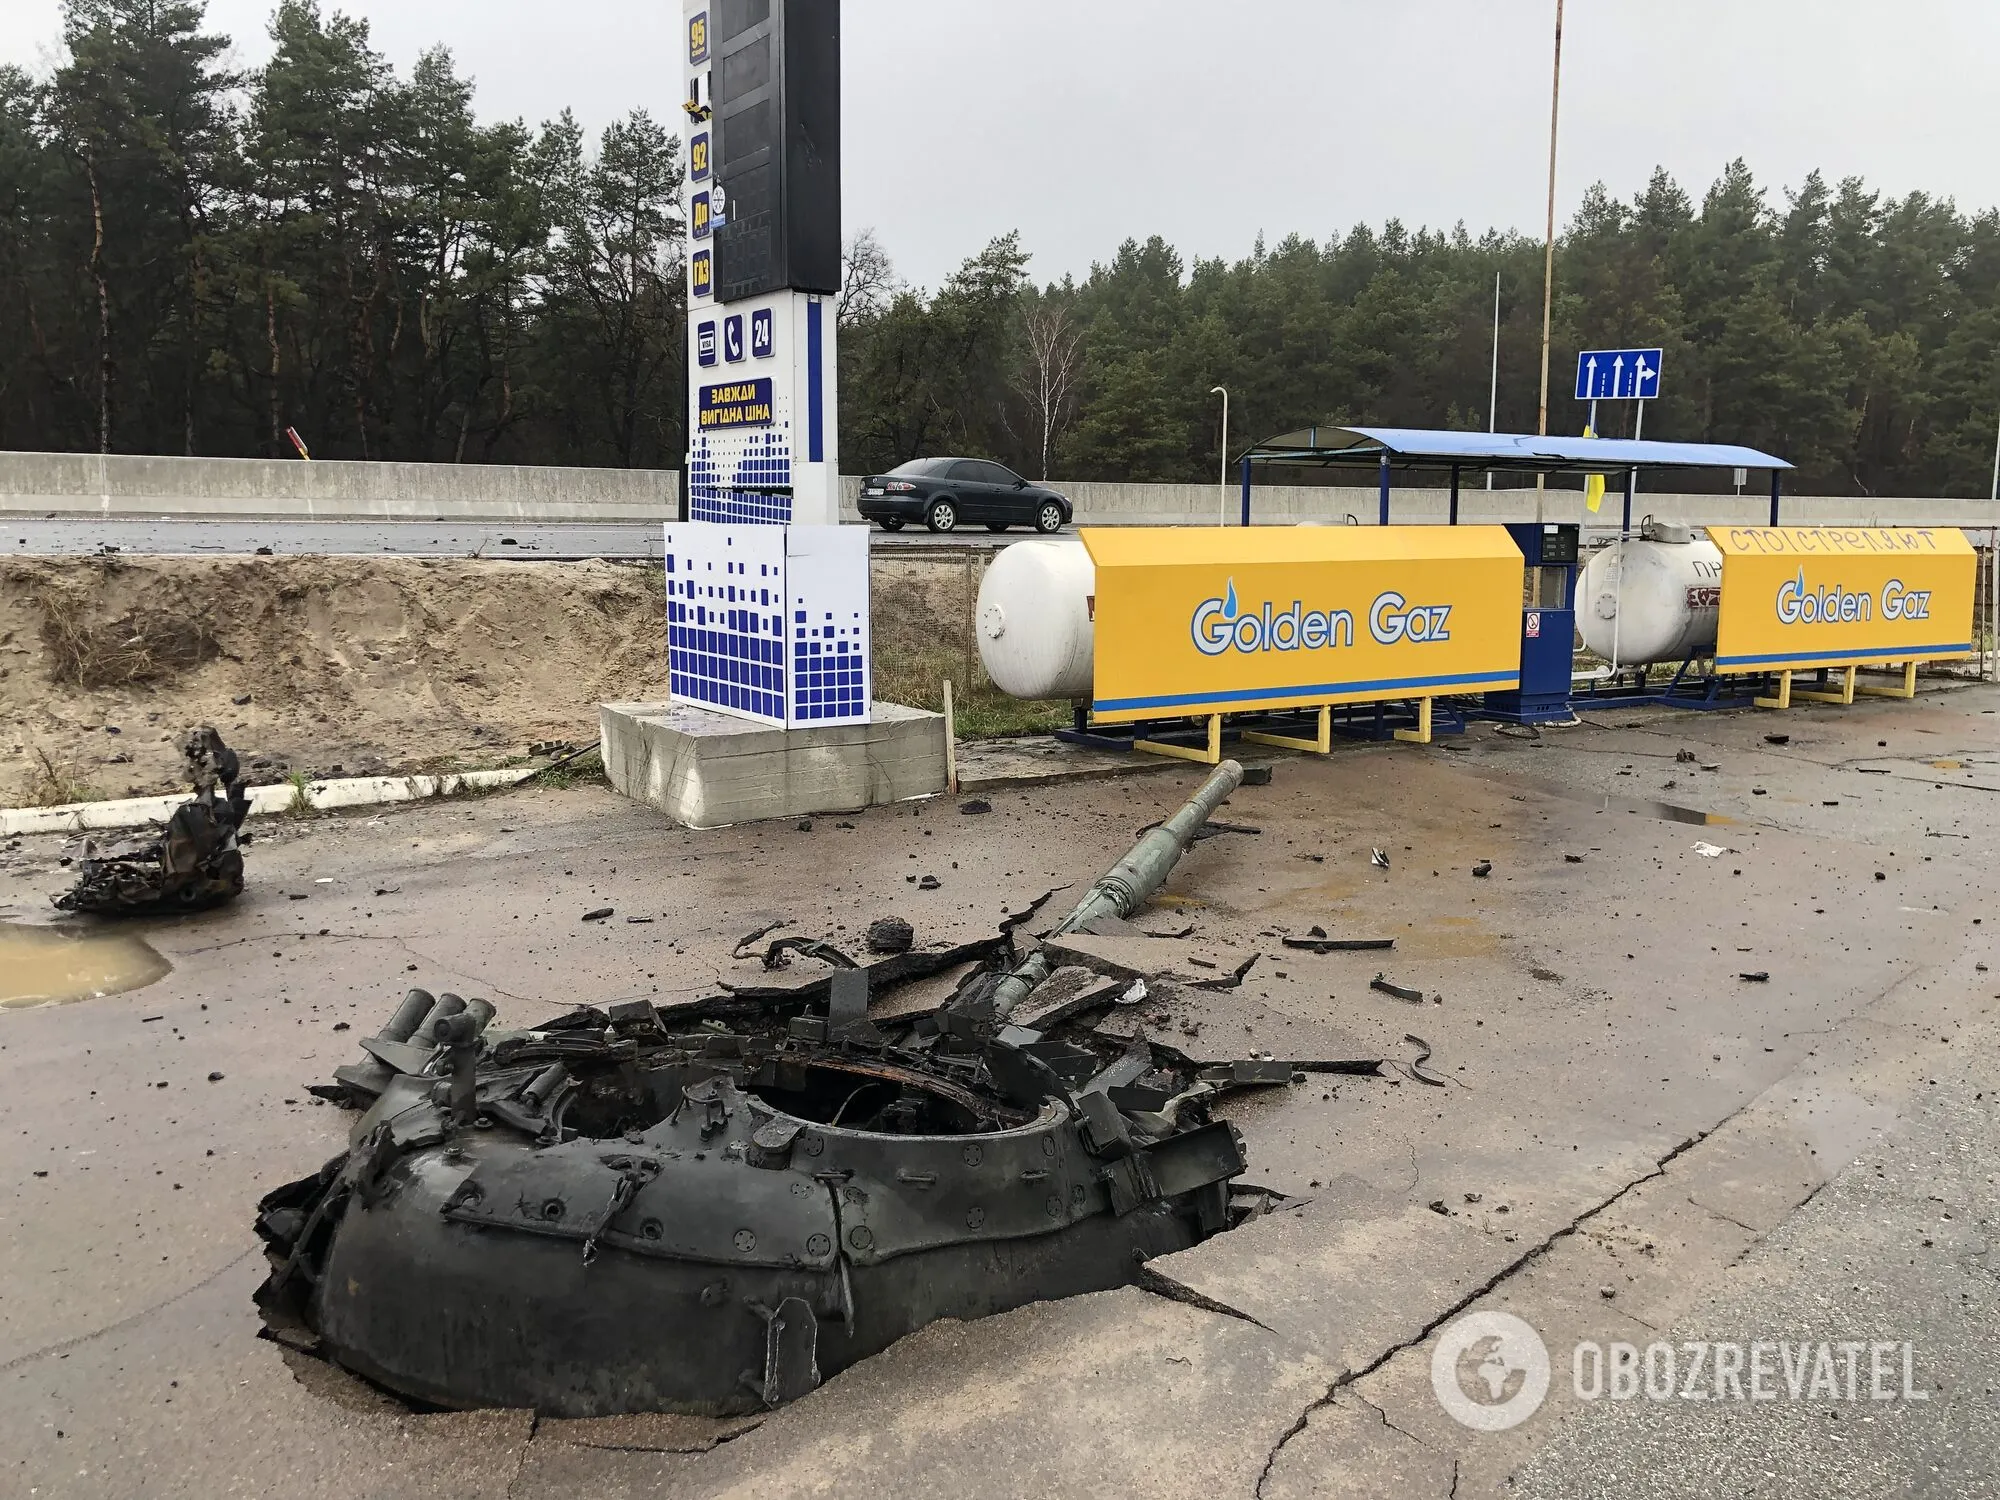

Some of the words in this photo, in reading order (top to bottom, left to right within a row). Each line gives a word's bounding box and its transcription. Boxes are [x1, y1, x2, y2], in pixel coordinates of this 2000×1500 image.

[691, 19, 705, 48] 95
[692, 141, 706, 172] 92
[693, 258, 709, 287] ГАЗ
[702, 340, 711, 348] VISA
[755, 318, 769, 348] 24
[711, 384, 756, 404] ЗАВЖДИ
[701, 406, 743, 425] ВИГІДНА
[745, 403, 771, 421] ЦІНА
[1776, 579, 1872, 624] Golden
[1880, 577, 1932, 621] Gaz
[1191, 597, 1354, 656] Golden
[1368, 590, 1453, 645] Gaz
